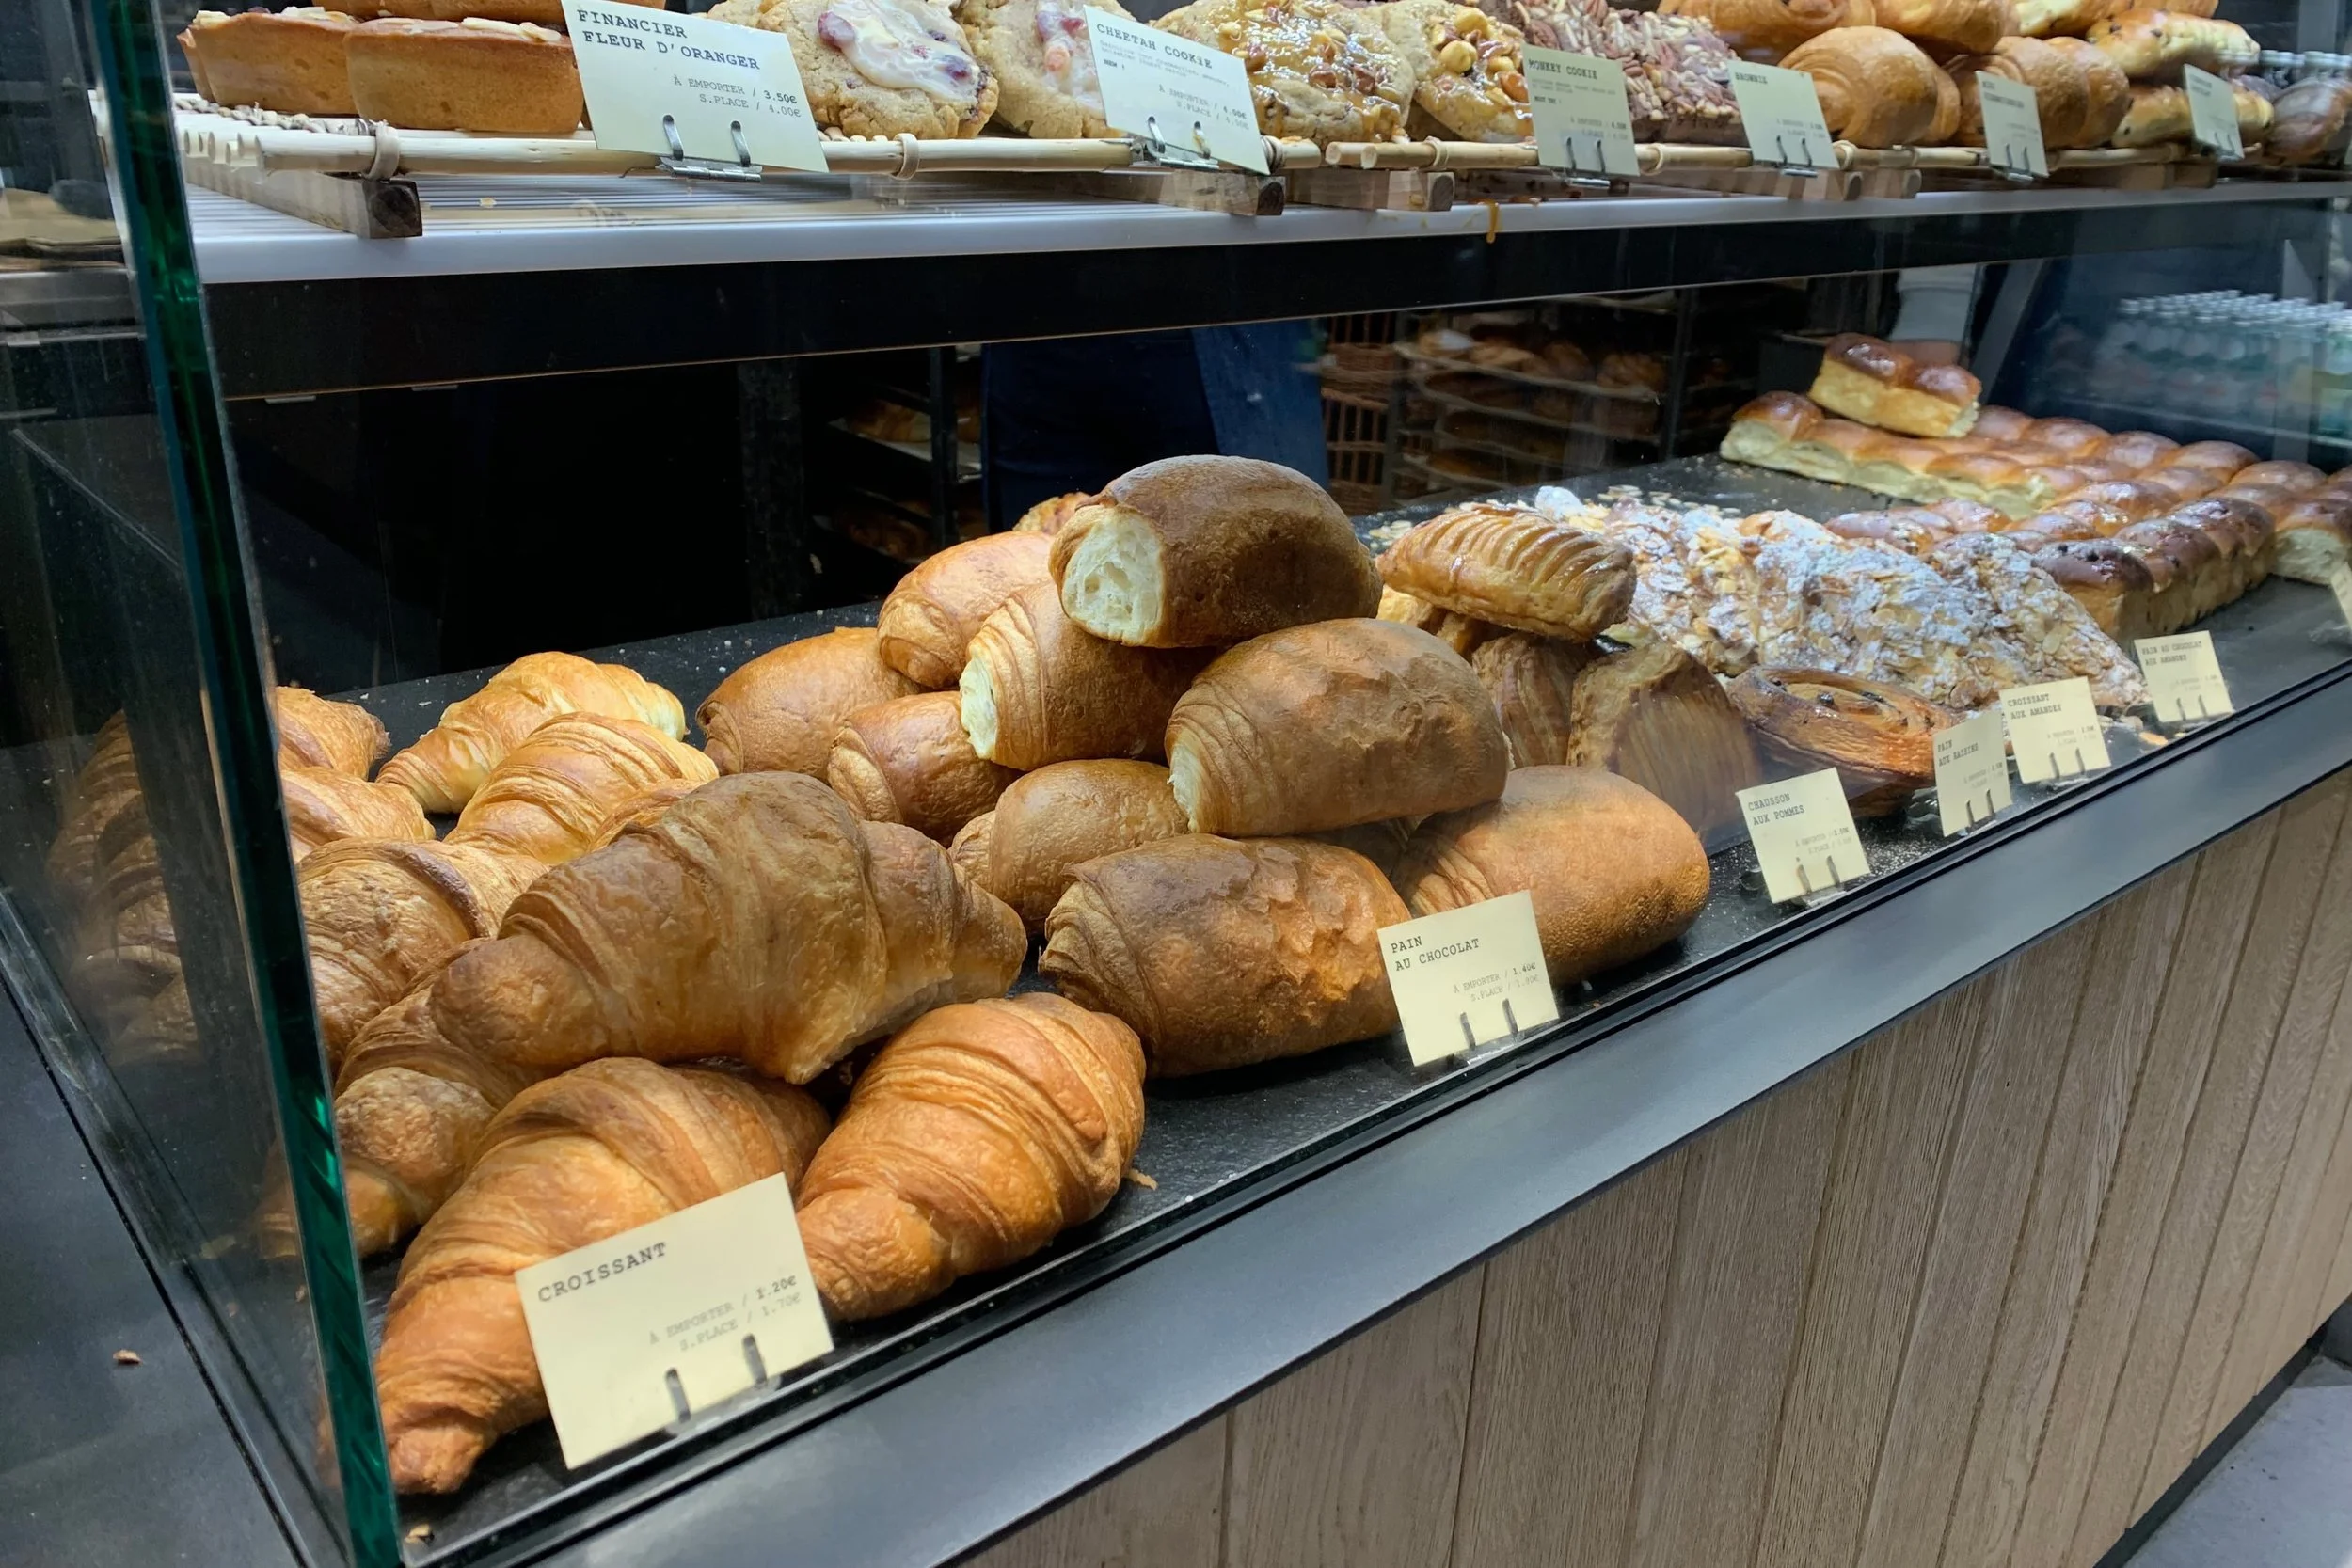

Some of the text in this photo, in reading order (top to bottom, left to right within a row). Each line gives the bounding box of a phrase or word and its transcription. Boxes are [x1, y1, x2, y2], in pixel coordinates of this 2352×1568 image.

[577, 9, 688, 39] FINANCIER
[583, 31, 760, 70] FLEUR D'ORANGER
[1096, 24, 1157, 51] CHEETAH
[1566, 65, 1597, 80] COOKIE
[689, 78, 745, 95] EMPORTER
[763, 89, 798, 104] 3.50€
[699, 93, 749, 108] S.PLACE
[769, 103, 801, 118] 4.00€
[2007, 693, 2050, 707] CROISSANT
[1748, 793, 1791, 811] CHAUSSON
[1753, 805, 1805, 826] AUX POMMES
[1391, 936, 1422, 954] PAIN
[1395, 938, 1480, 972] AU CHOCOLAT
[1463, 973, 1501, 991] EMPORTER
[537, 1242, 667, 1303] CROISSANT
[666, 1302, 735, 1338] EMPORTER
[756, 1275, 797, 1300] 1.20€
[679, 1319, 739, 1352] S.PLACE
